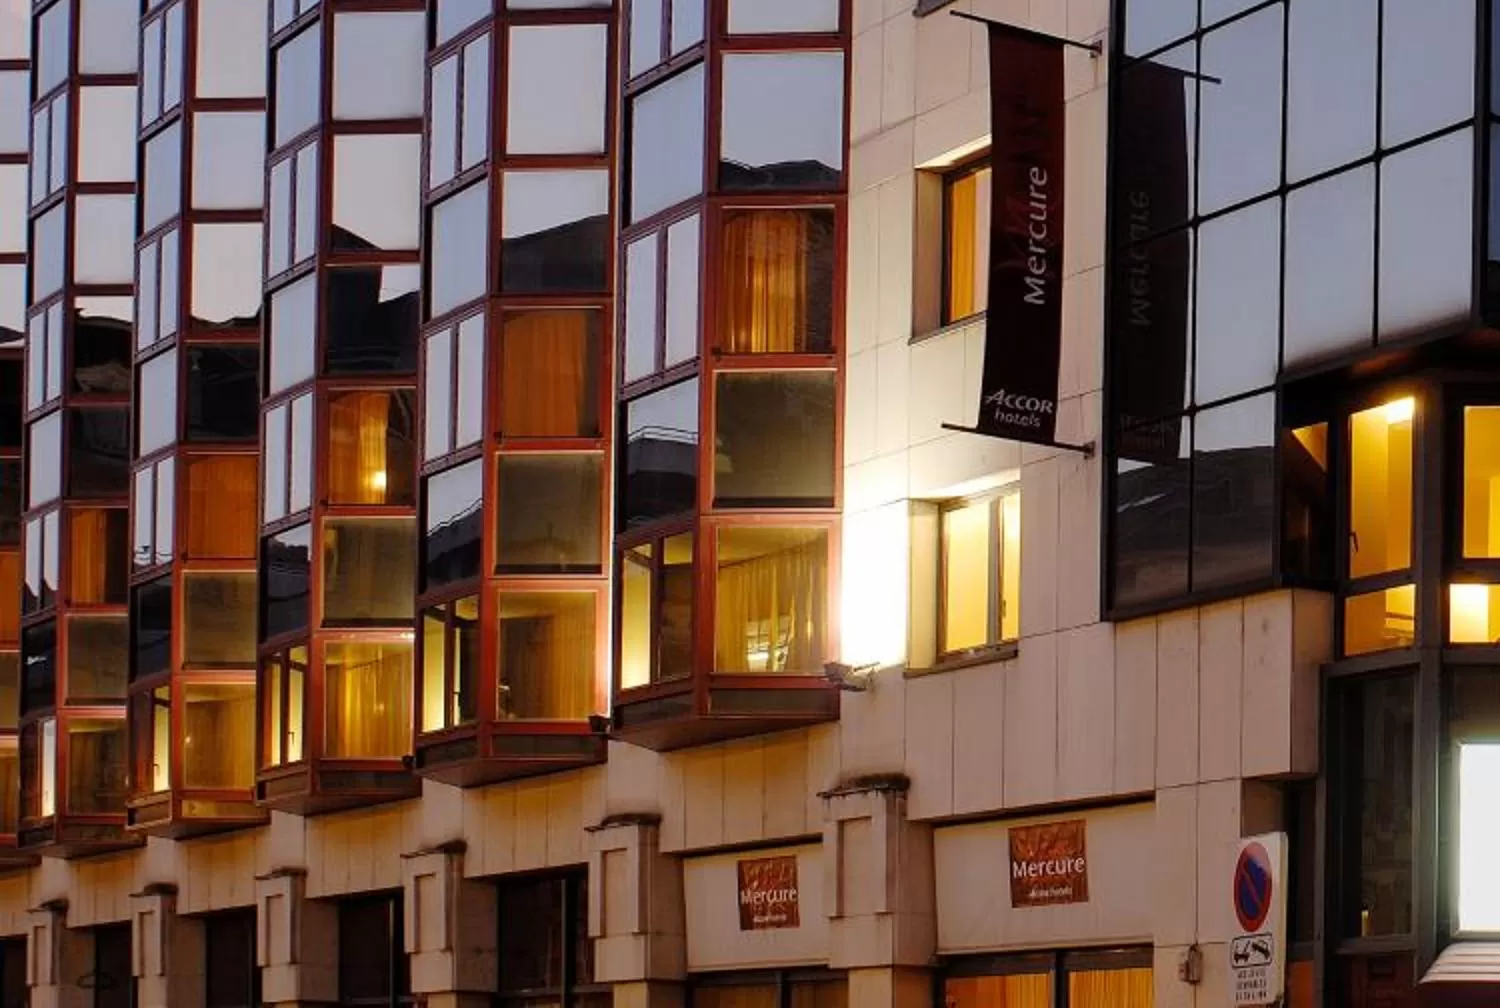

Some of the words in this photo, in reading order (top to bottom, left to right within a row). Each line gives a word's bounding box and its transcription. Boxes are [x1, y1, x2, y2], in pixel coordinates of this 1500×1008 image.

[1024, 166, 1048, 304] Mercure
[984, 388, 1053, 414] ACCOR
[994, 408, 1041, 427] hotels
[1012, 857, 1085, 879] Mercure
[741, 888, 797, 905] Mercure
